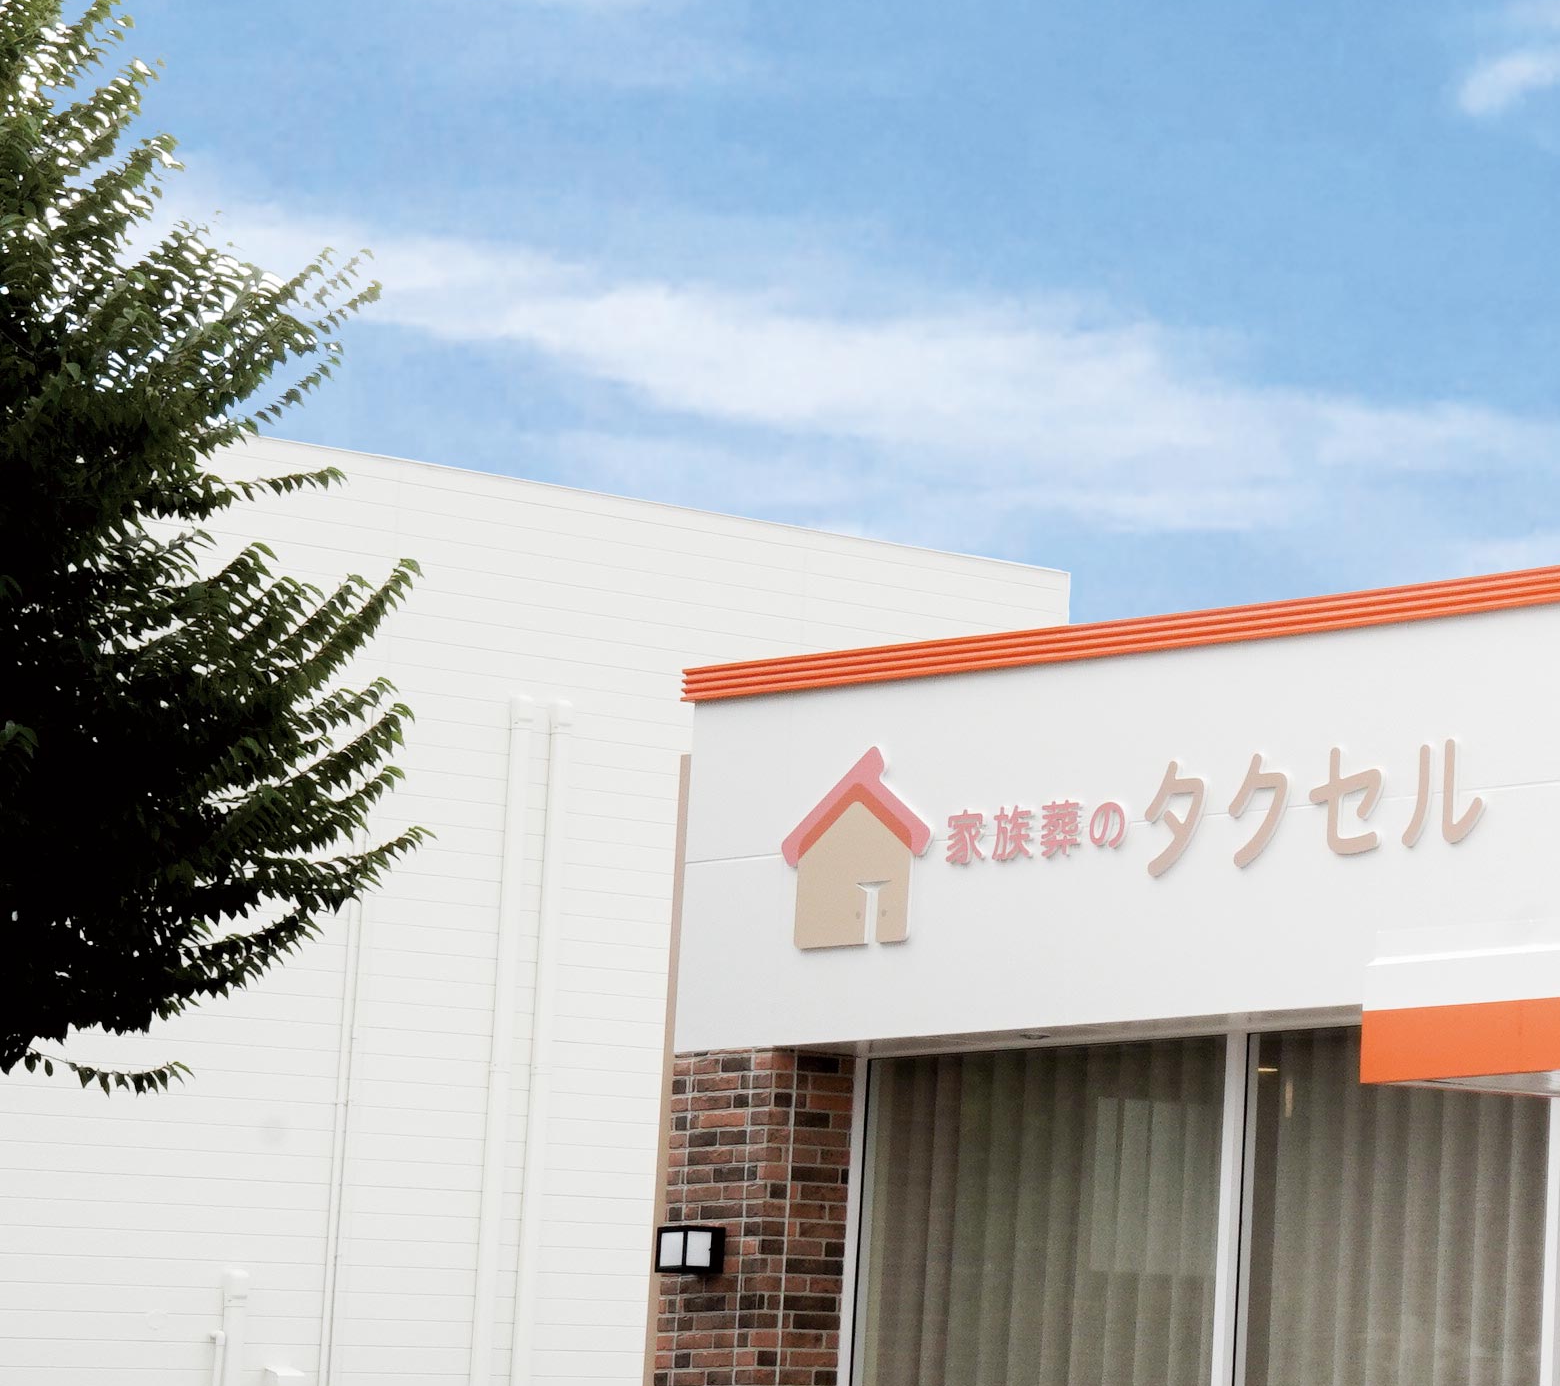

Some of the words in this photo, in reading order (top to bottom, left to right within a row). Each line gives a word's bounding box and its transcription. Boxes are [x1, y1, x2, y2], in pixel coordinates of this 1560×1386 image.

[945, 738, 1486, 878] 家族葬のタクセル
